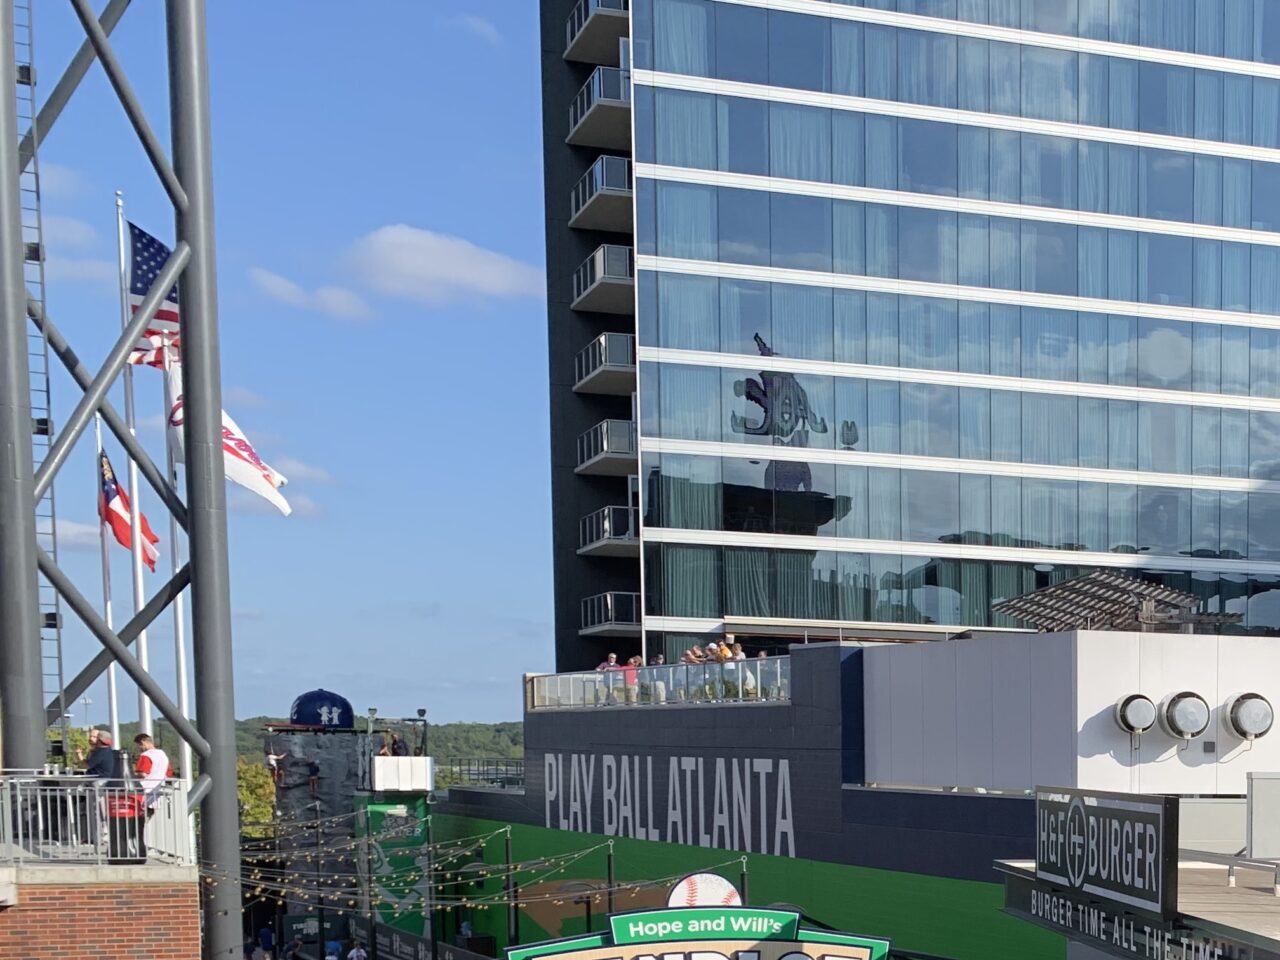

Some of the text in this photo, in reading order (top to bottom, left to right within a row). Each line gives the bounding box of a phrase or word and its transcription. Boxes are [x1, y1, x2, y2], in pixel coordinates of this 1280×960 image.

[544, 753, 796, 858] PLAY BALL ATLANTA
[1039, 808, 1065, 868] H&F
[1088, 815, 1158, 892] BURGER
[628, 914, 784, 938] Hope and Will's
[1030, 889, 1073, 928] BURGER
[1078, 904, 1107, 941] TIME
[1112, 915, 1138, 952] ALL
